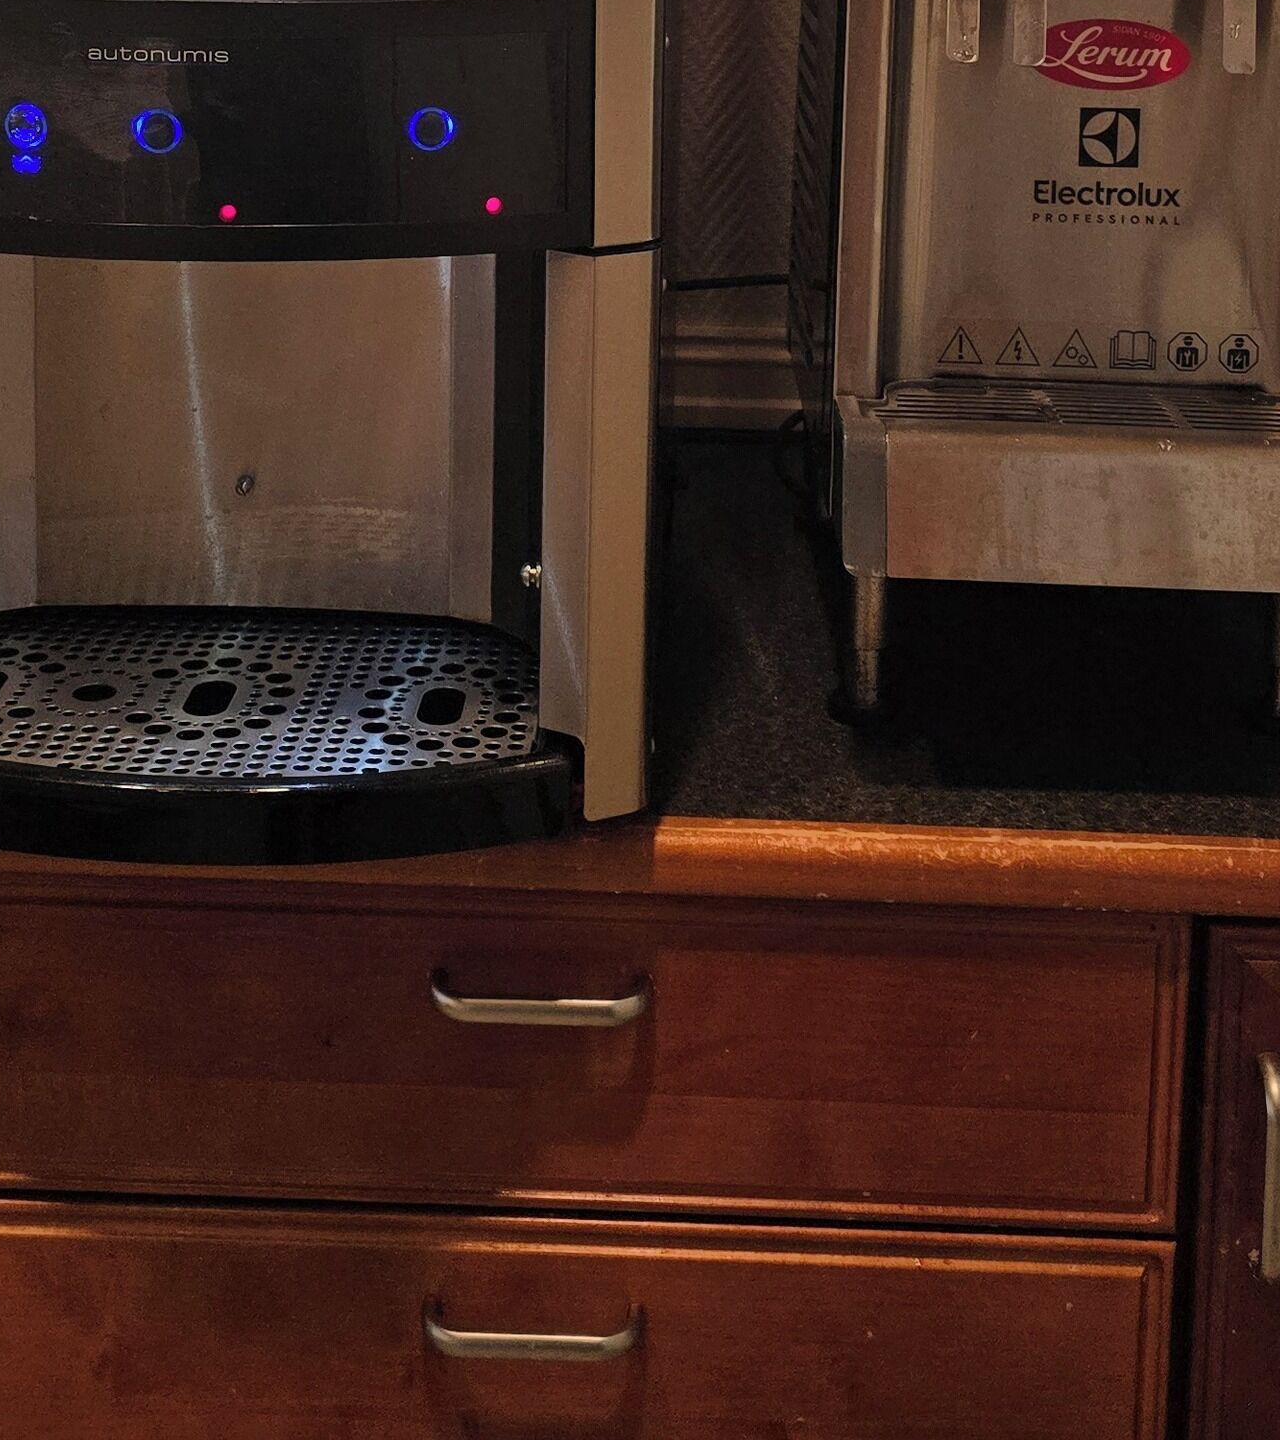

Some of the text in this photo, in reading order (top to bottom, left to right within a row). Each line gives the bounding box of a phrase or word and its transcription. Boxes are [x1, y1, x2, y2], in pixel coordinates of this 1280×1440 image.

[87, 45, 230, 66] autonumis
[1039, 26, 1173, 83] Lerum
[1034, 180, 1181, 208] Electrolux
[1032, 212, 1181, 226] PROFESSIONAL
